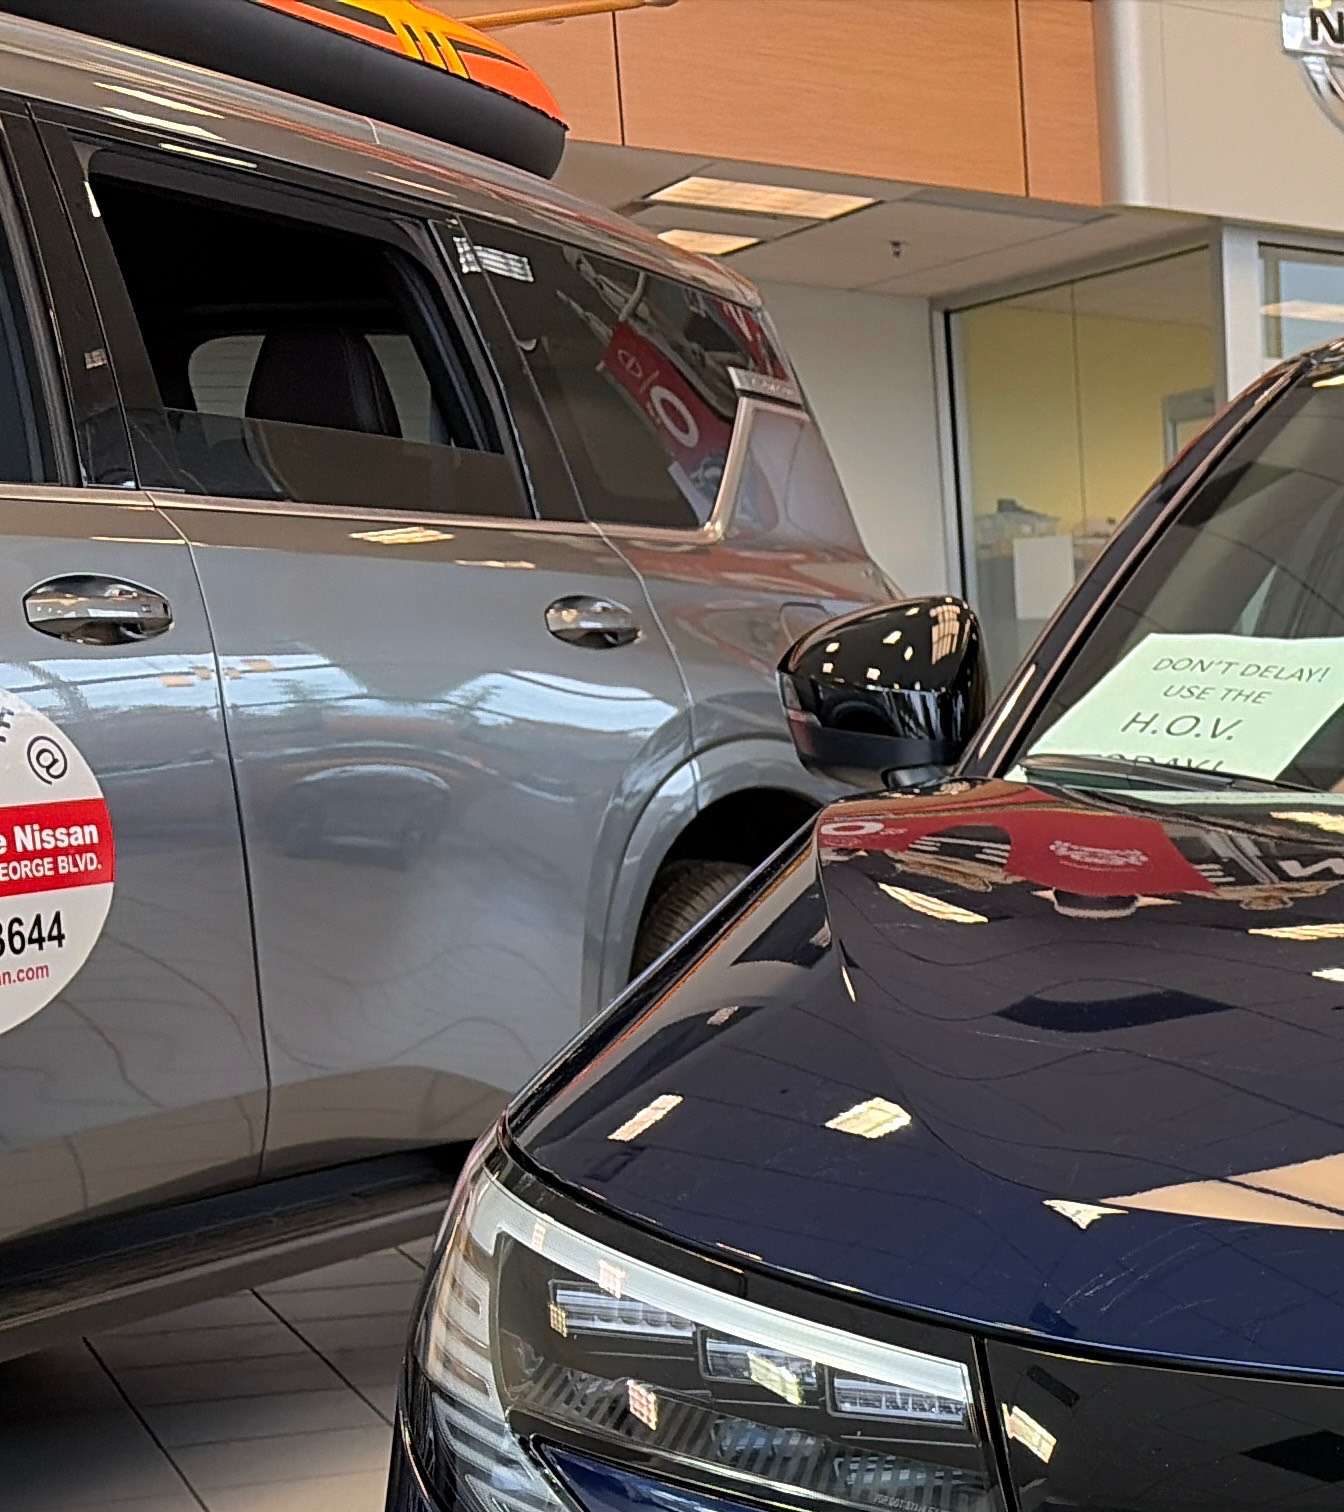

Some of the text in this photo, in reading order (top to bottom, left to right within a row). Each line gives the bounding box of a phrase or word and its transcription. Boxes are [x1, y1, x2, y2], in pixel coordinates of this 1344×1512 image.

[1152, 657, 1331, 683] DON'T DELAY!
[1163, 684, 1272, 704] USE THE
[1121, 711, 1243, 741] H.O.V.
[13, 823, 99, 854] Nissan
[57, 852, 102, 876] BLVD.
[0, 964, 49, 987] n.com
